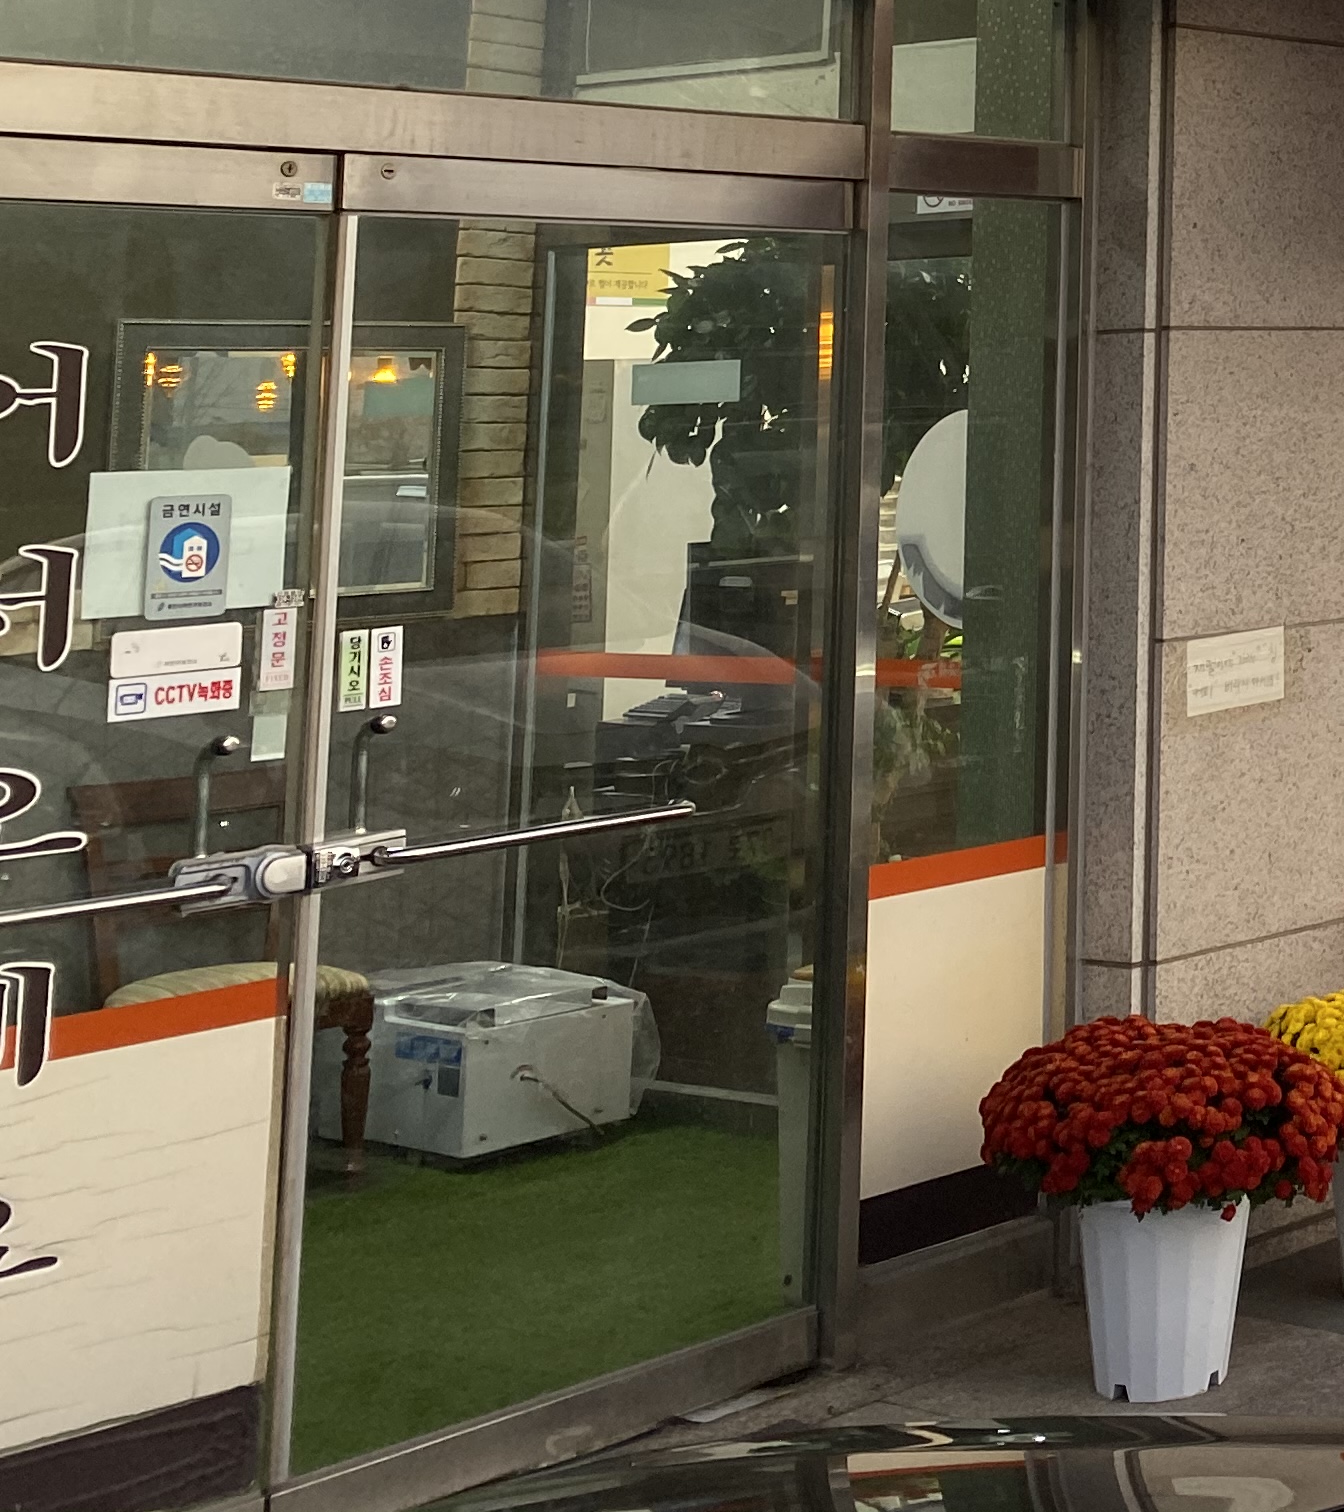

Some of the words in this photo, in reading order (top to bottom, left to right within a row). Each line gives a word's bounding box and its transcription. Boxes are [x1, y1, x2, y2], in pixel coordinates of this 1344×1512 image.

[162, 503, 221, 519] 금연시설
[271, 612, 288, 668] 고정문
[348, 636, 361, 691] 당기시오
[378, 656, 393, 702] 손조심
